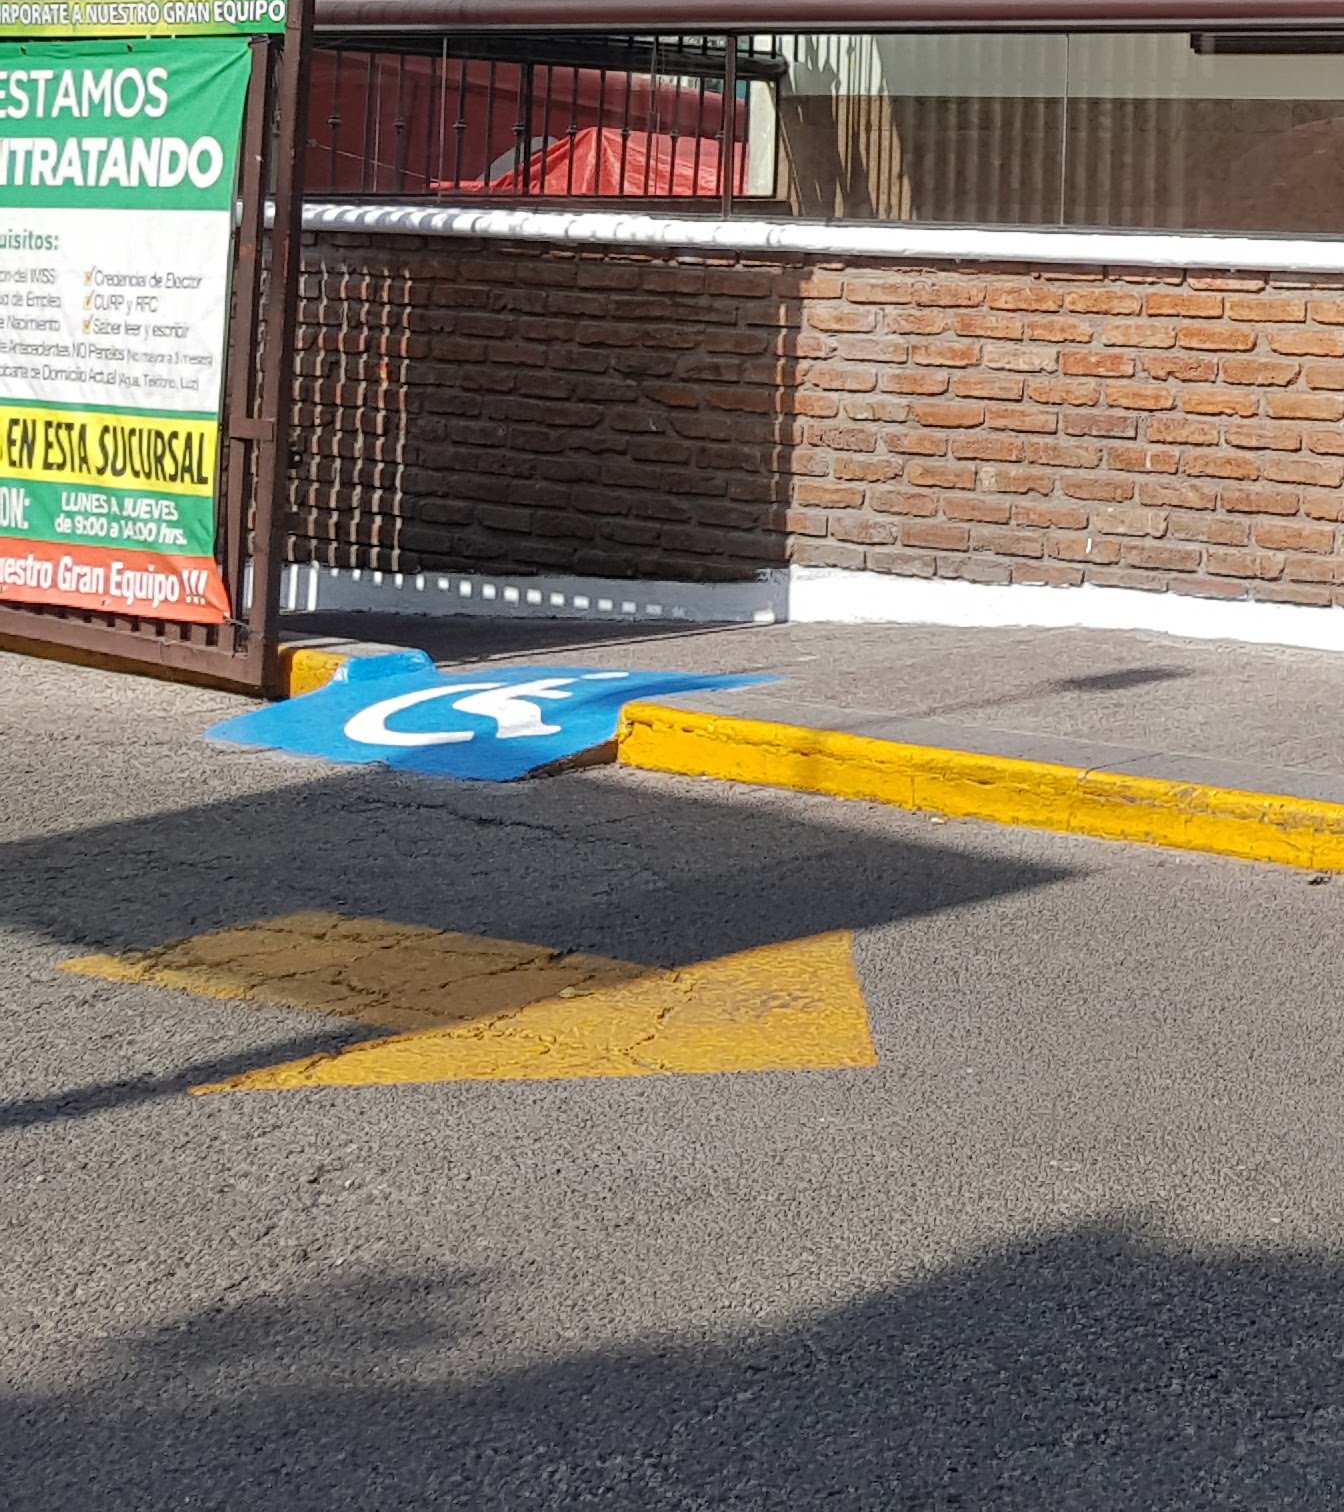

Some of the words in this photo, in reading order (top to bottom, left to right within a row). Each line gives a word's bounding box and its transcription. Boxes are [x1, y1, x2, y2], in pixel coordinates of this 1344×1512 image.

[71, 2, 82, 24] A
[86, 1, 160, 25] NUESTRO
[163, 1, 209, 24] GRAN
[7, 418, 37, 469] EN
[42, 420, 91, 474] ESTA
[95, 424, 209, 484] SUCURSAL
[61, 491, 109, 514] LUNES
[123, 497, 179, 521] JUEVES
[55, 513, 72, 533] de
[75, 516, 107, 536] 9:00
[110, 522, 118, 538] a
[159, 522, 187, 545] hrs.
[57, 555, 104, 594] Gran
[109, 561, 180, 608] Equipo
